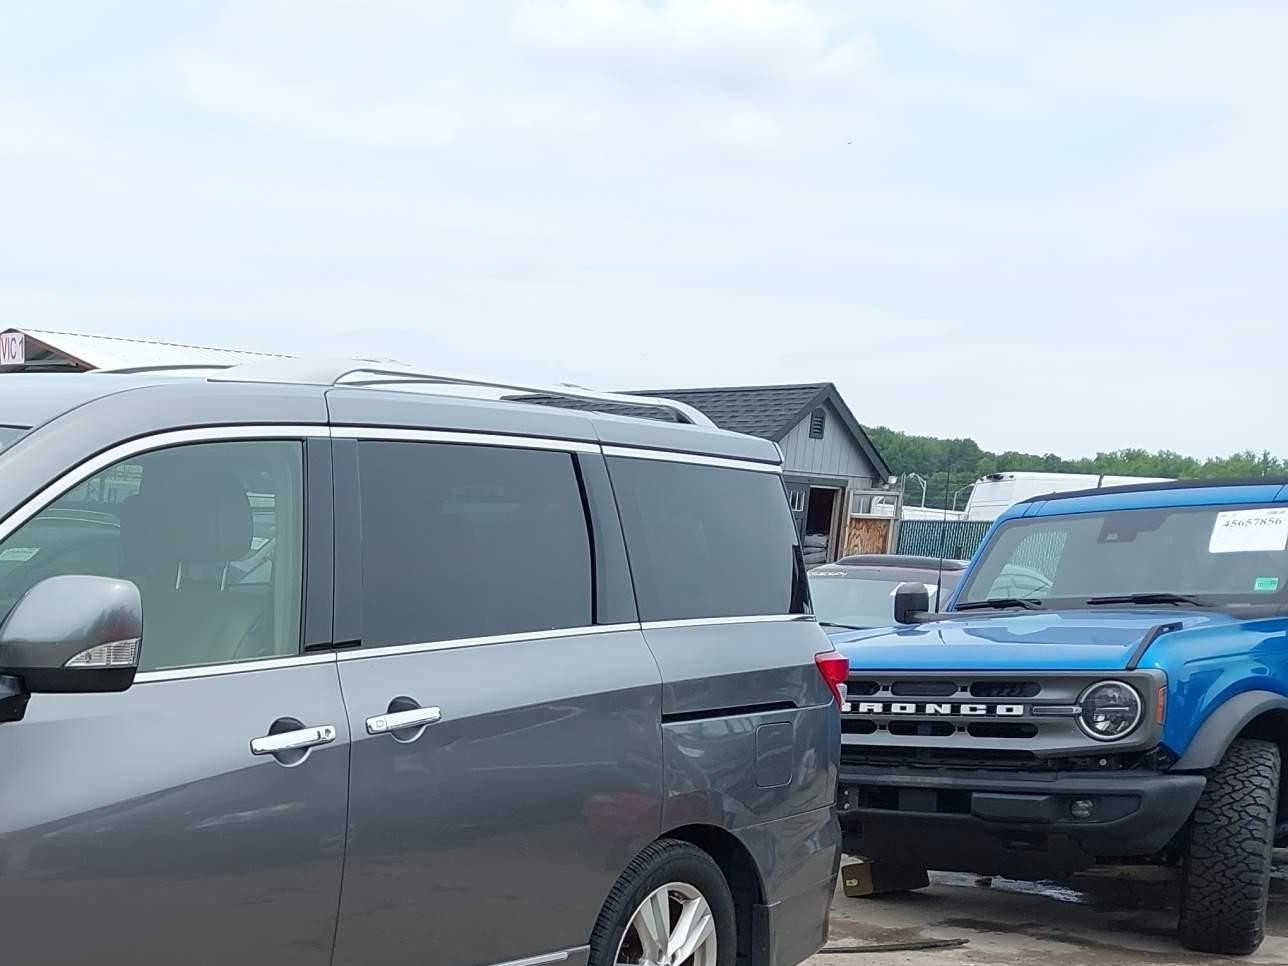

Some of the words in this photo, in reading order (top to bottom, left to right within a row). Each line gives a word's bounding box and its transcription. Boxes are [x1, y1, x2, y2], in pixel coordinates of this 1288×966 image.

[2, 336, 16, 360] VIC
[19, 336, 23, 360] 1
[1223, 517, 1283, 528] 45657856
